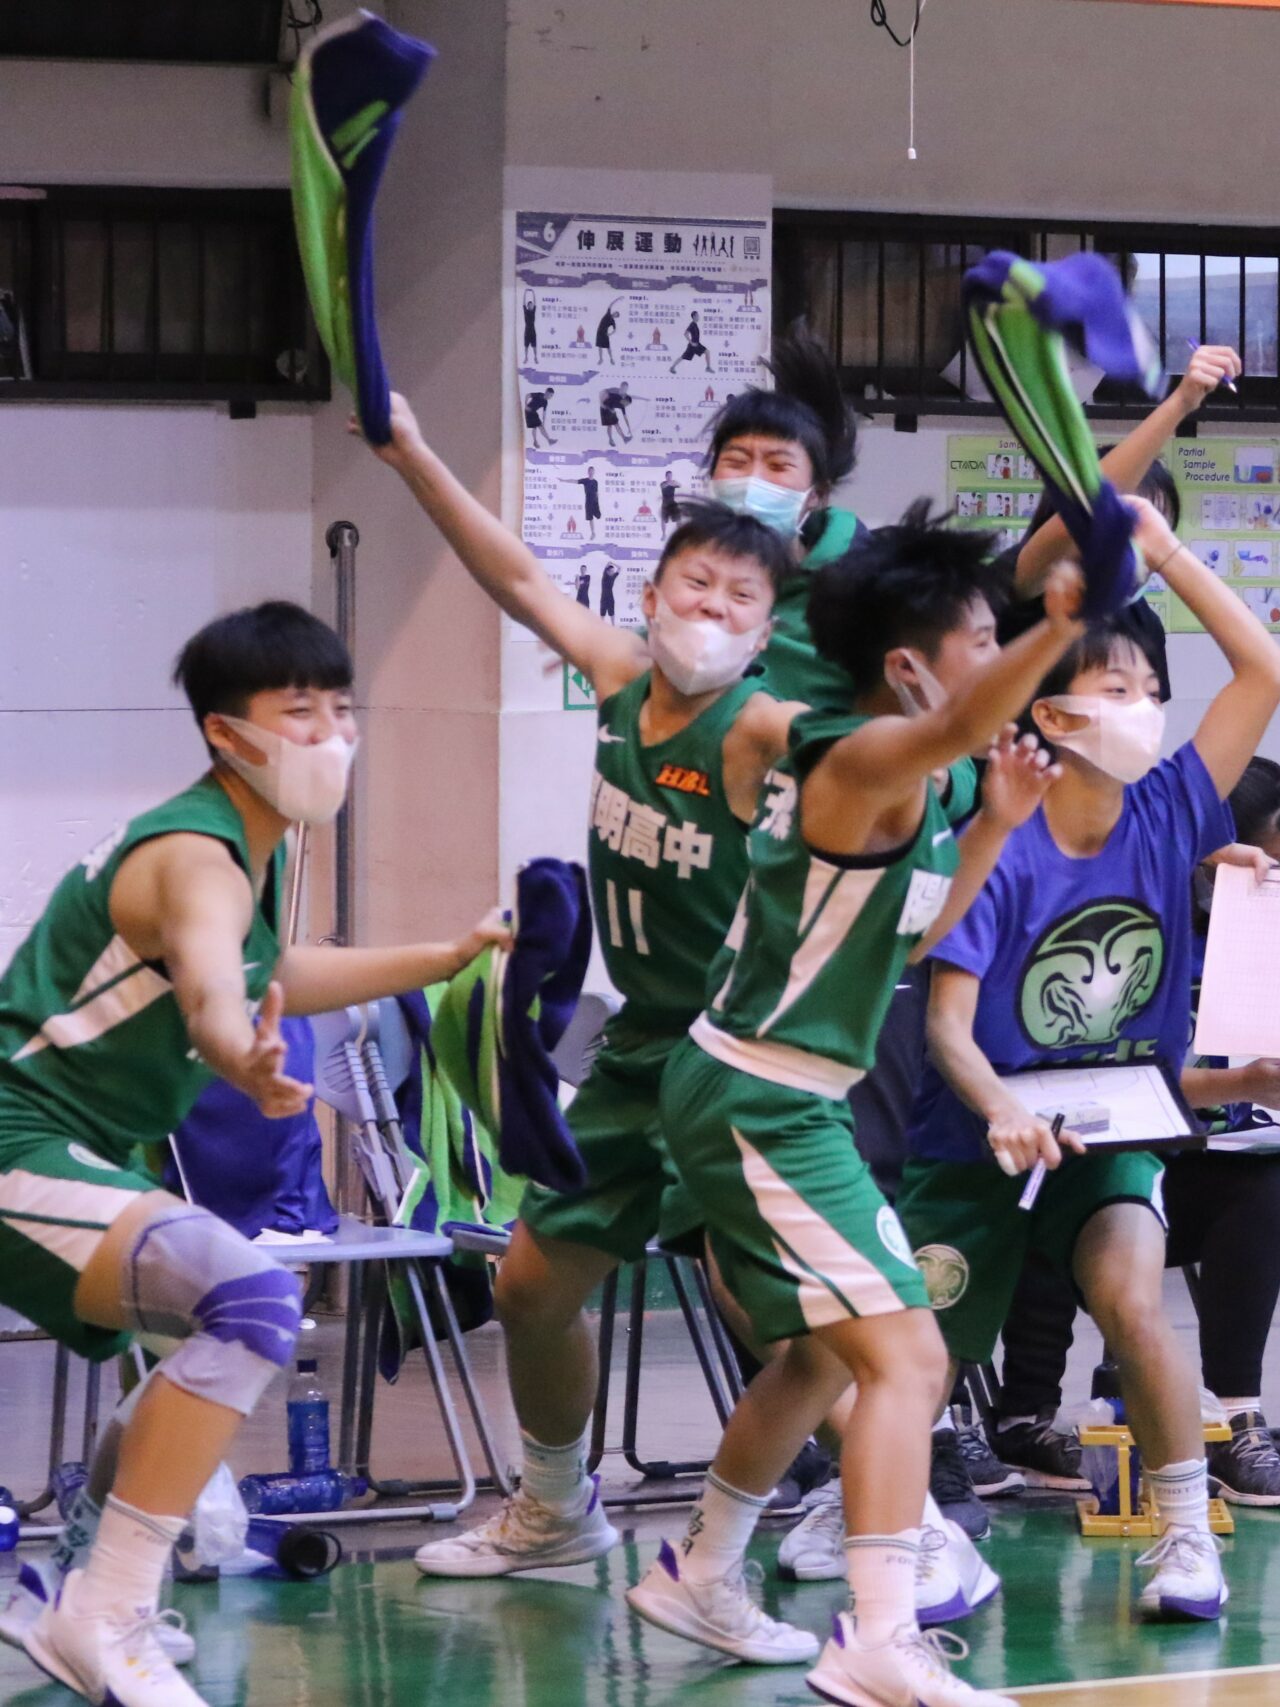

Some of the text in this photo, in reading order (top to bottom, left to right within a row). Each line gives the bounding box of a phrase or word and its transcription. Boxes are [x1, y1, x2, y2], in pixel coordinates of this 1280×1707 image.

[543, 221, 556, 243] 6
[577, 229, 682, 253] 伸展運動
[1178, 447, 1205, 457] Partial
[1183, 459, 1216, 470] Sample
[1185, 471, 1230, 482] Procedure
[590, 769, 713, 880] 明高中
[606, 878, 650, 956] 11
